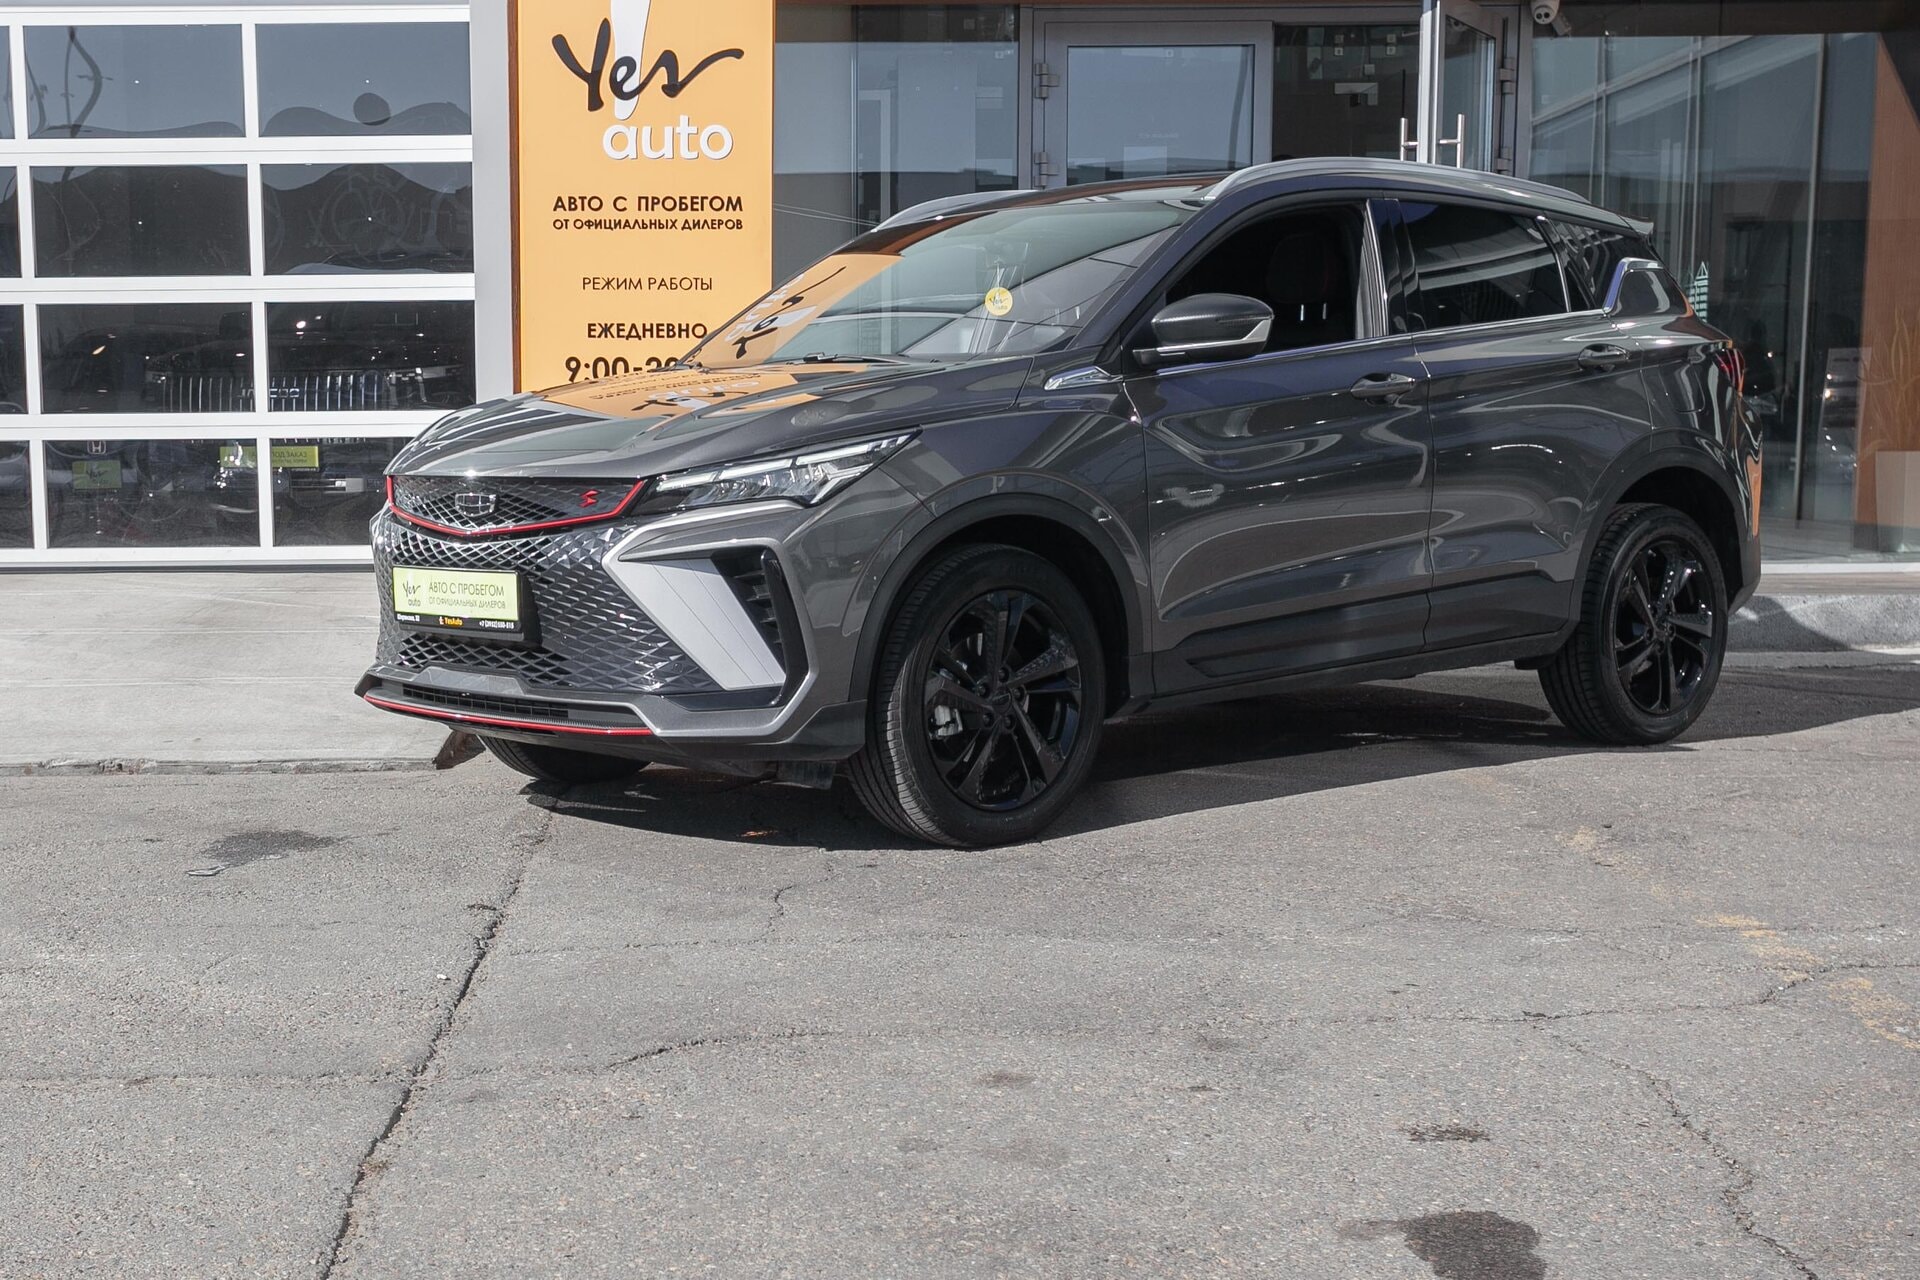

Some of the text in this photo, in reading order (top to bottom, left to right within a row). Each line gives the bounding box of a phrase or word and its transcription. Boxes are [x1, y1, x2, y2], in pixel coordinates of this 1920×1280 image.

[552, 17, 745, 112] Yes
[602, 114, 734, 160] auto
[553, 196, 743, 212] АВТО С ПРОБЕГОМ
[553, 219, 743, 231] ОТ ОФИЦИАЛЬНЫХ ДИЛЕРОВ
[582, 277, 713, 290] РЕЖИМ РАБОТЫ
[587, 323, 708, 340] ЕЖЕДНЕВНО
[565, 356, 680, 383] 9:00-
[429, 581, 505, 597] АВТО С ПРОБЕГОМ
[408, 598, 421, 608] auto
[435, 597, 477, 608] ОФИЦИАЛЬНЫХ
[479, 600, 506, 610] ДИЛЕРОВ
